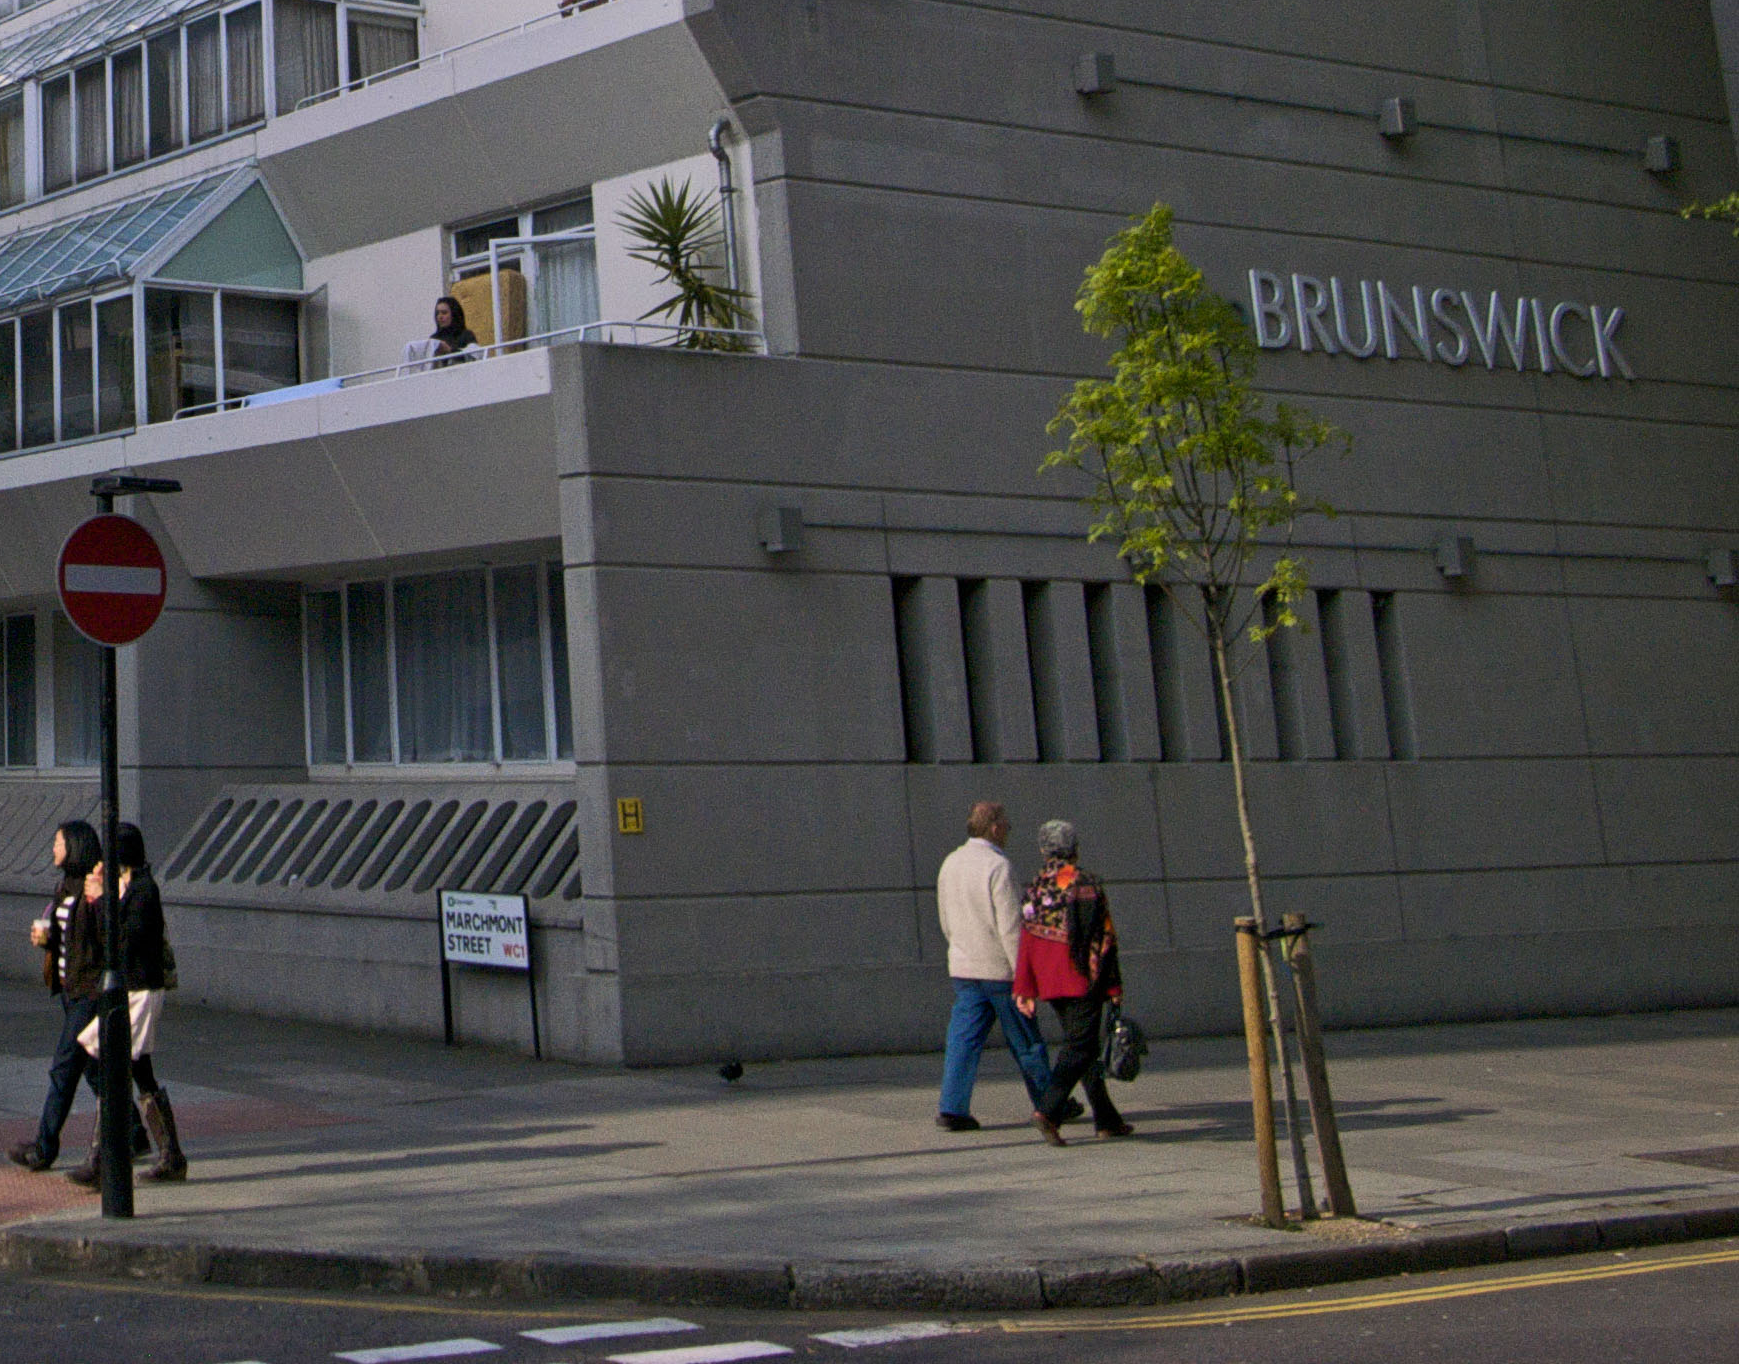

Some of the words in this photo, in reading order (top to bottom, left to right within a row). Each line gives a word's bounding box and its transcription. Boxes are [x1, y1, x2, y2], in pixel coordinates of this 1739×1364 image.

[1249, 268, 1636, 381] BRUNSWICK
[621, 801, 640, 829] H
[446, 912, 523, 934] MARCHMONT
[448, 934, 491, 954] STREET
[503, 943, 525, 959] WC1
